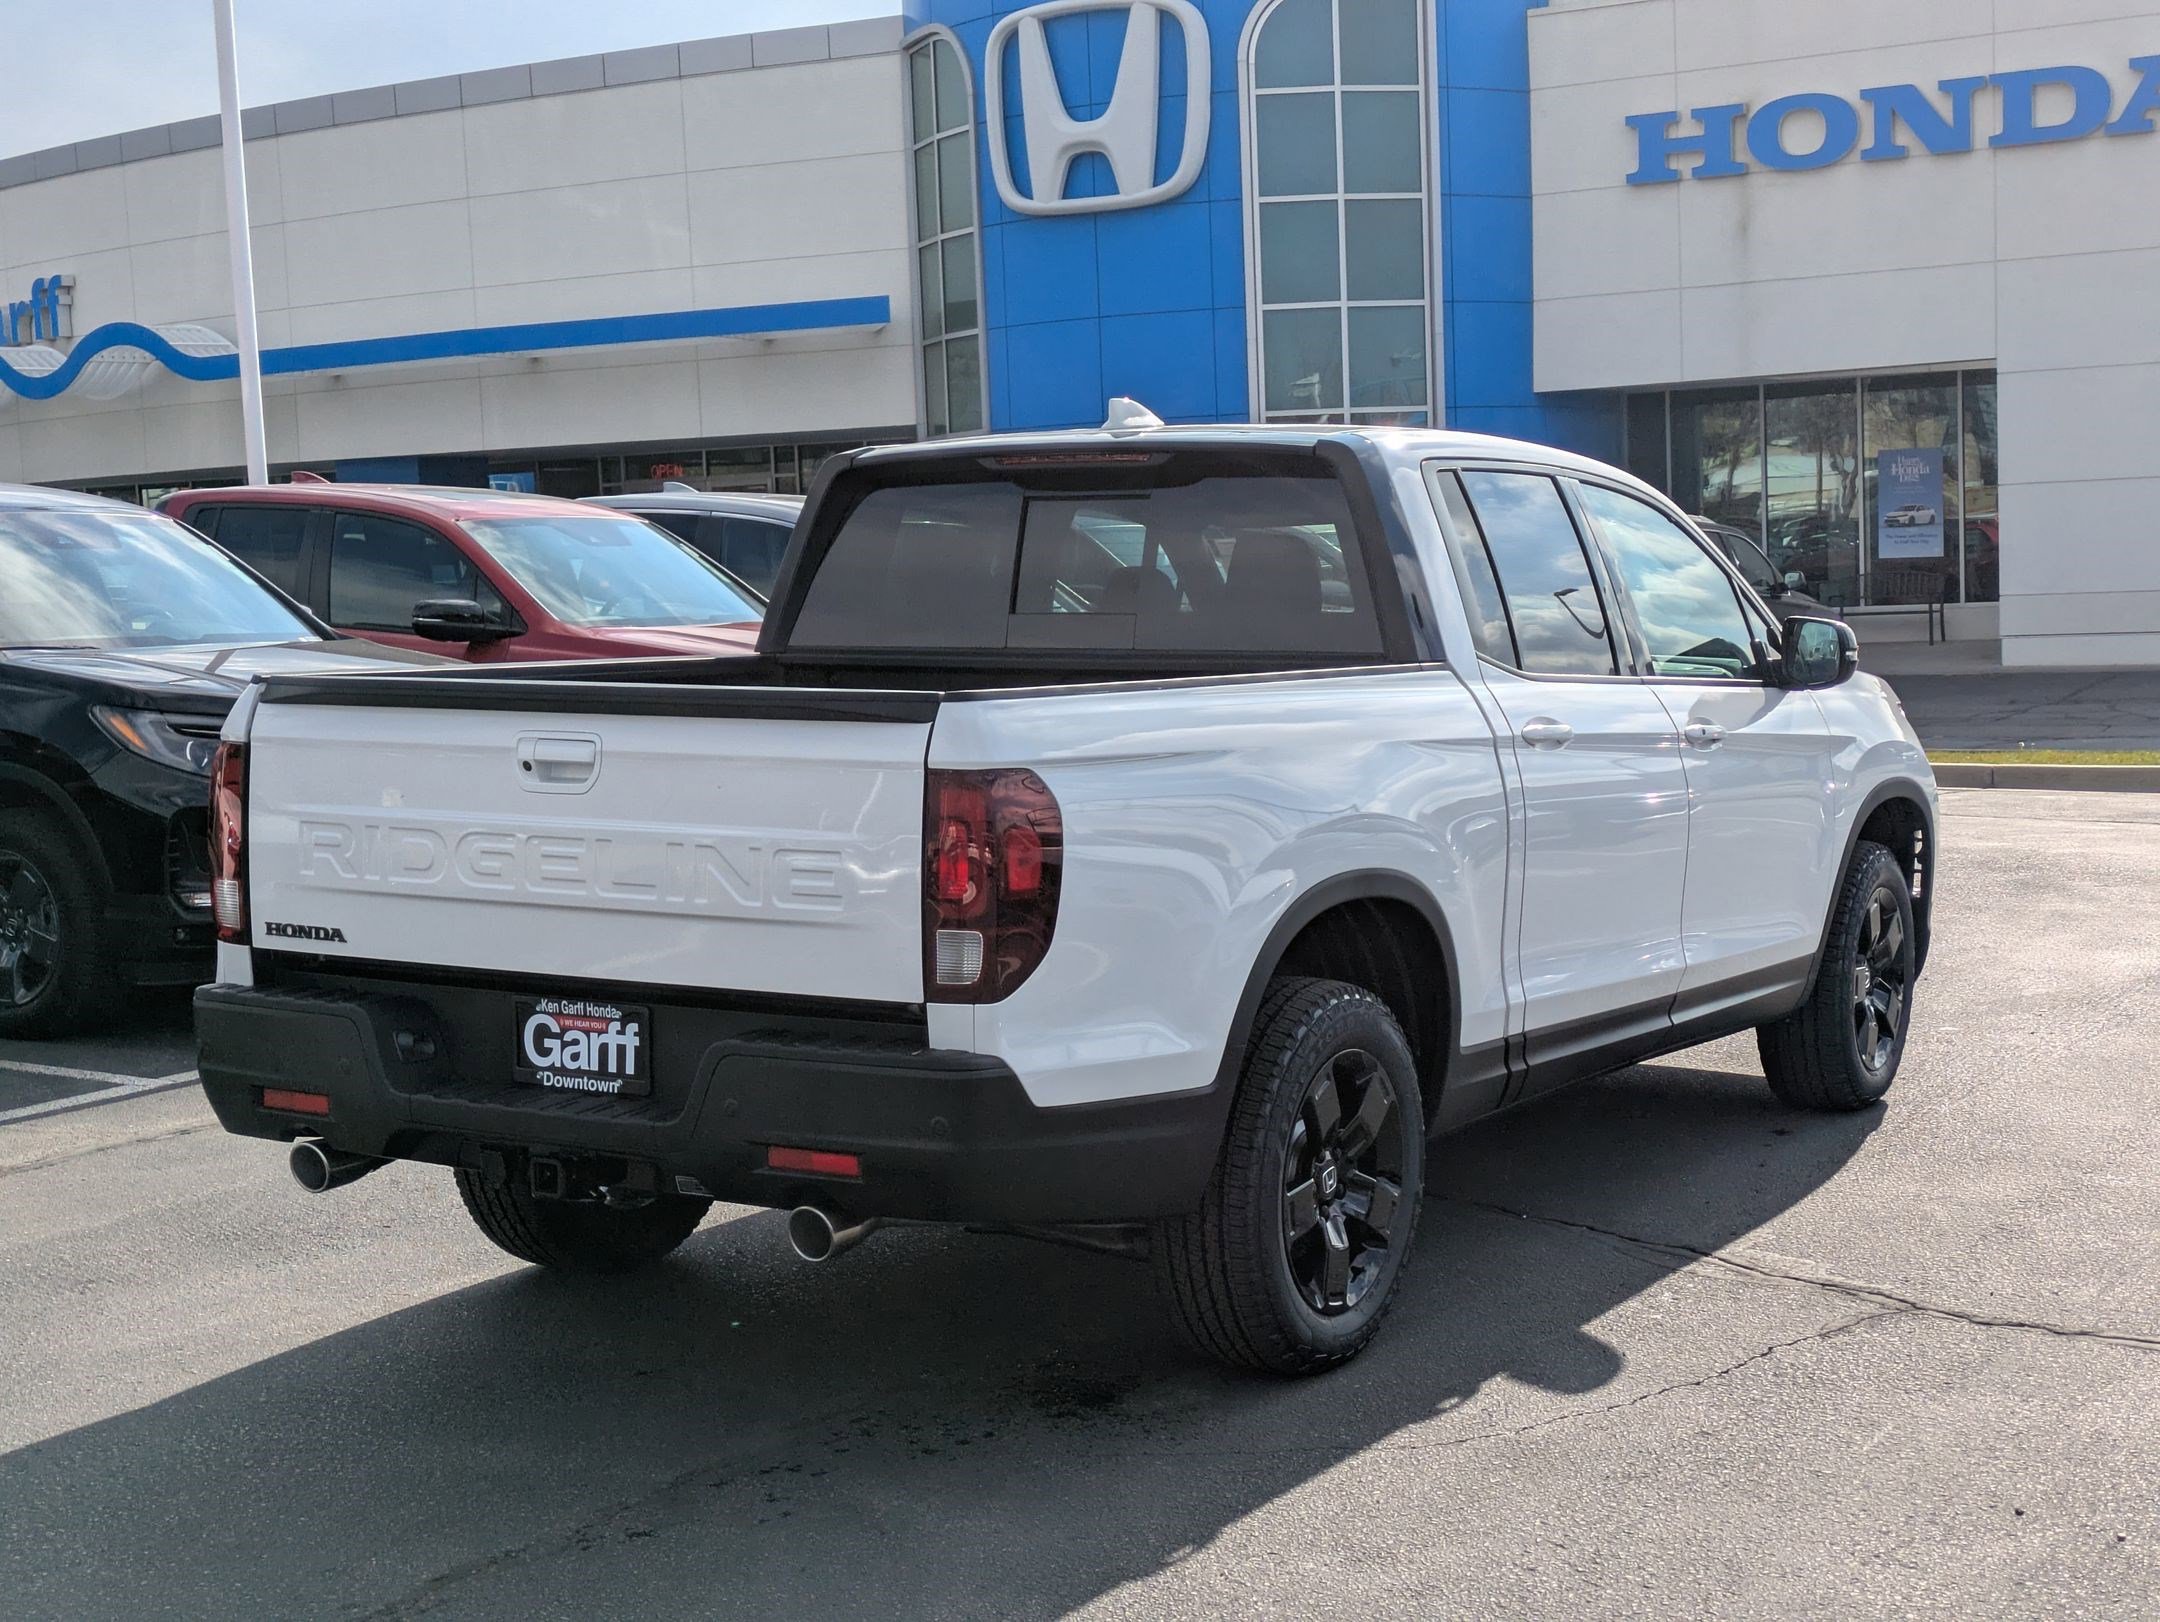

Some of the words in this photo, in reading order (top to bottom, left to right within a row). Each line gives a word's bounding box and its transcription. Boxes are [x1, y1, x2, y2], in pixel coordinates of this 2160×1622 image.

[651, 464, 684, 479] OPEN
[299, 820, 844, 912] RIDGELINE
[264, 921, 348, 943] HONDA
[541, 998, 559, 1014] Ken
[561, 1000, 584, 1016] Garff
[586, 1002, 619, 1019] Honda
[564, 1019, 574, 1027] WE
[574, 1020, 590, 1028] HEAR
[590, 1021, 602, 1029] YOU
[523, 1013, 640, 1075] Garff
[543, 1071, 619, 1094] Downtown
